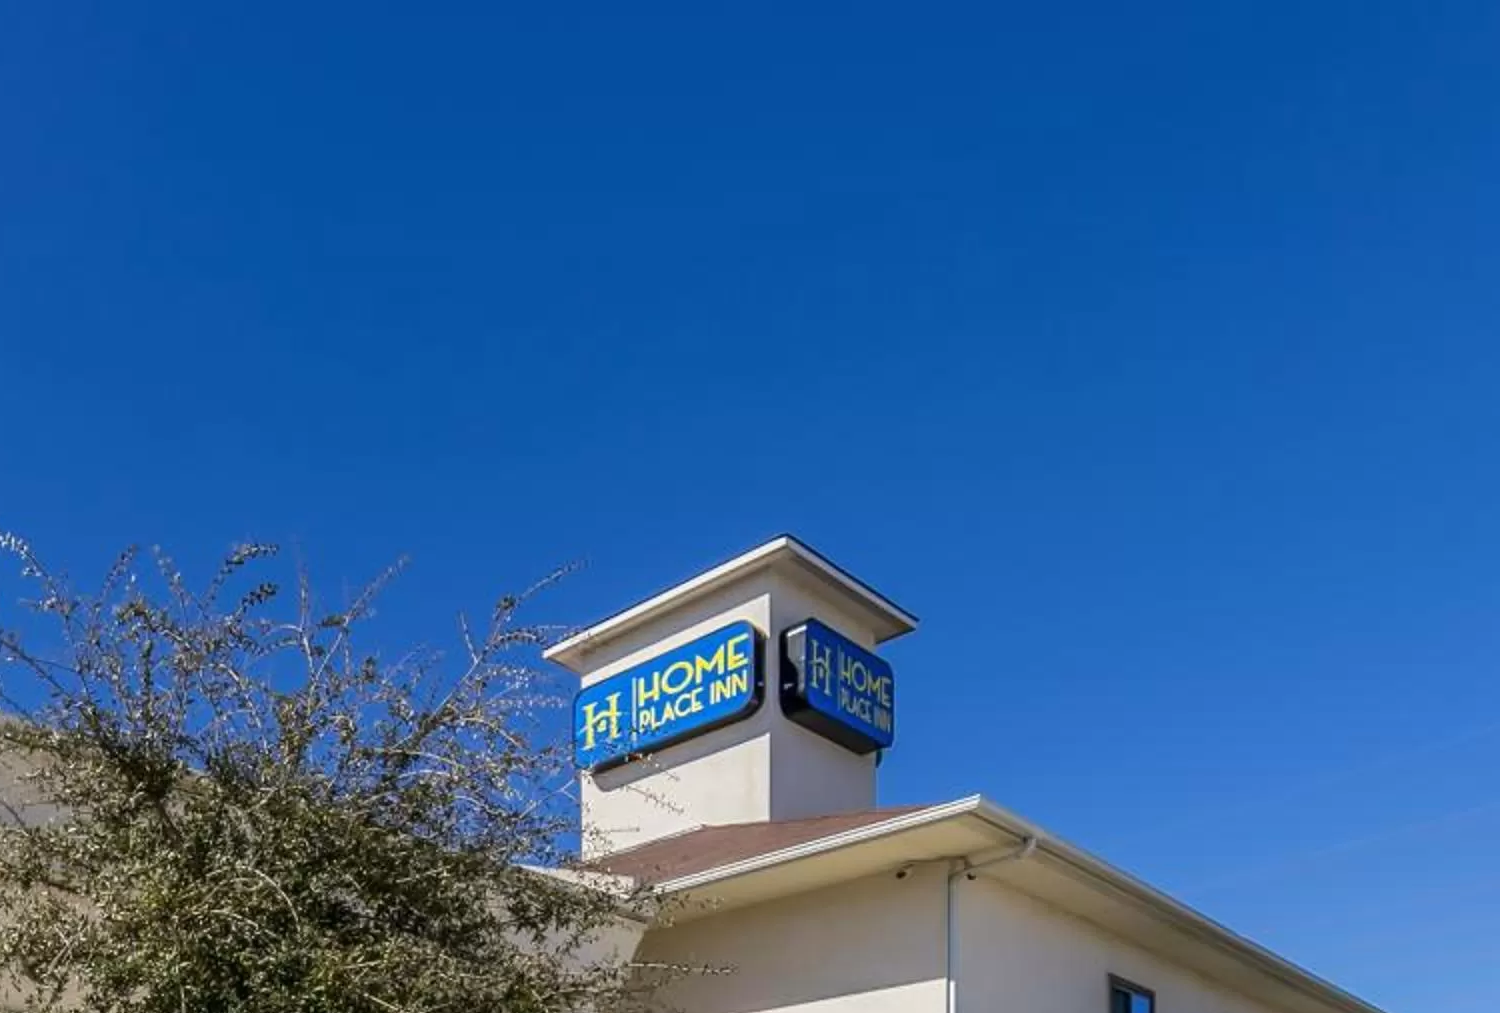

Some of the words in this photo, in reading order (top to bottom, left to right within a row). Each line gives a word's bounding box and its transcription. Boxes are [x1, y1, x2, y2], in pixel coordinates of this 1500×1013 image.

[638, 633, 749, 706] HOME
[639, 687, 705, 733] PLACE
[710, 669, 748, 704] INN
[840, 651, 892, 709] HOME
